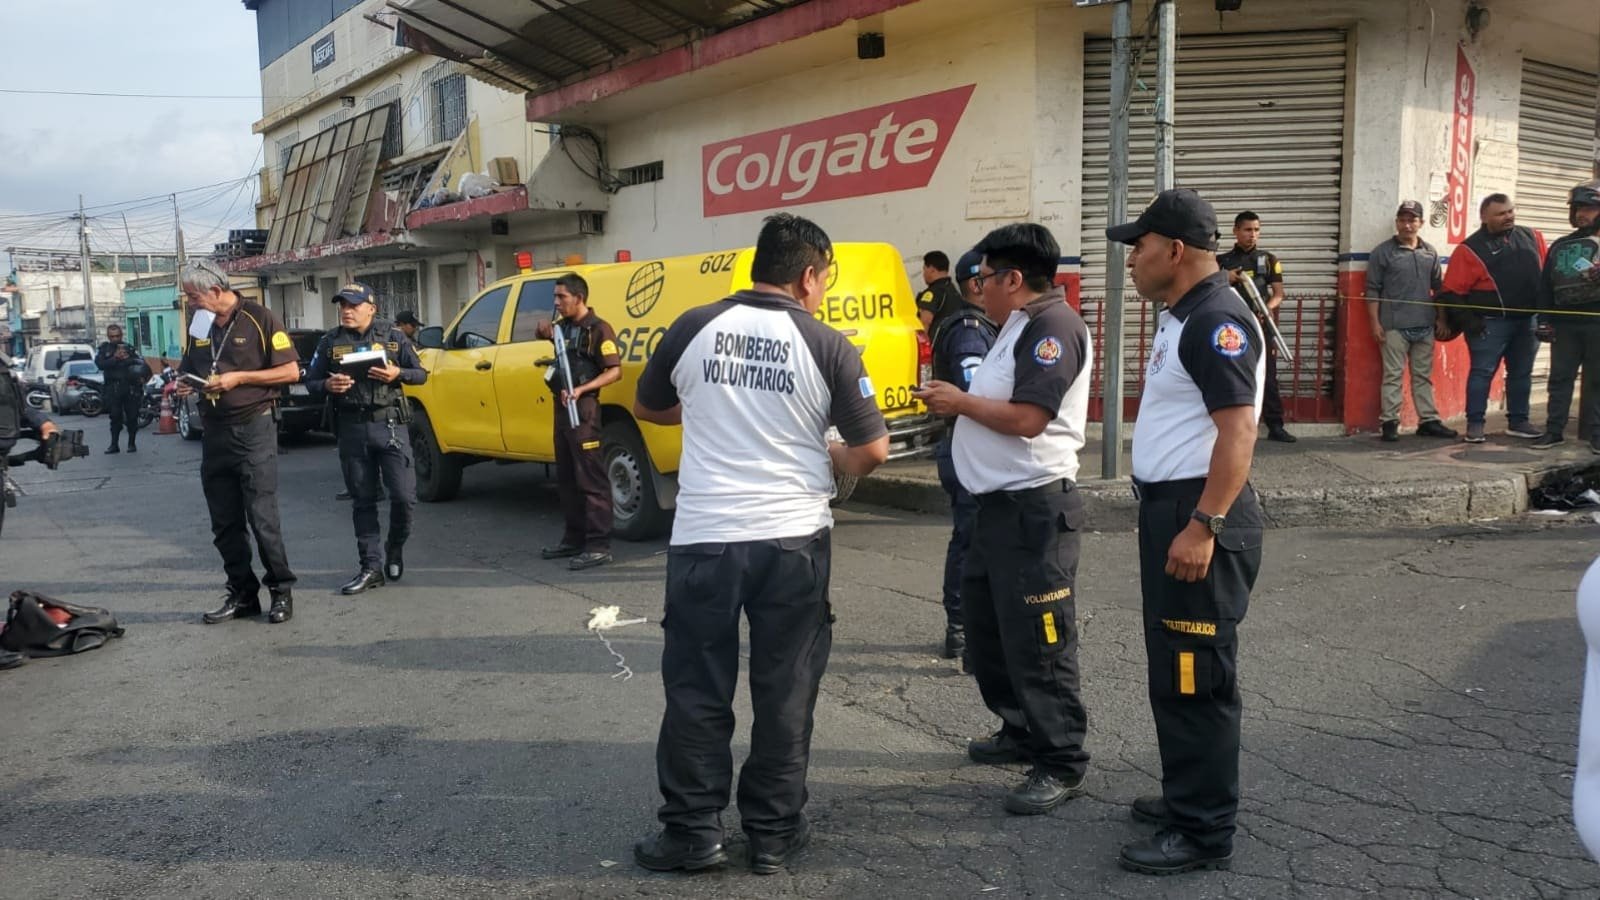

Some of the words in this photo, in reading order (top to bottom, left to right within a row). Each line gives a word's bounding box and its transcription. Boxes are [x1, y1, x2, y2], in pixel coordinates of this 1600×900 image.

[707, 111, 938, 201] Colgate
[1450, 74, 1470, 237] Colgate
[700, 252, 736, 275] 602
[714, 331, 791, 364] BOMBEROS
[703, 358, 795, 395] VOLUNTARIOS
[1023, 587, 1071, 604] VOLUNTARIOS
